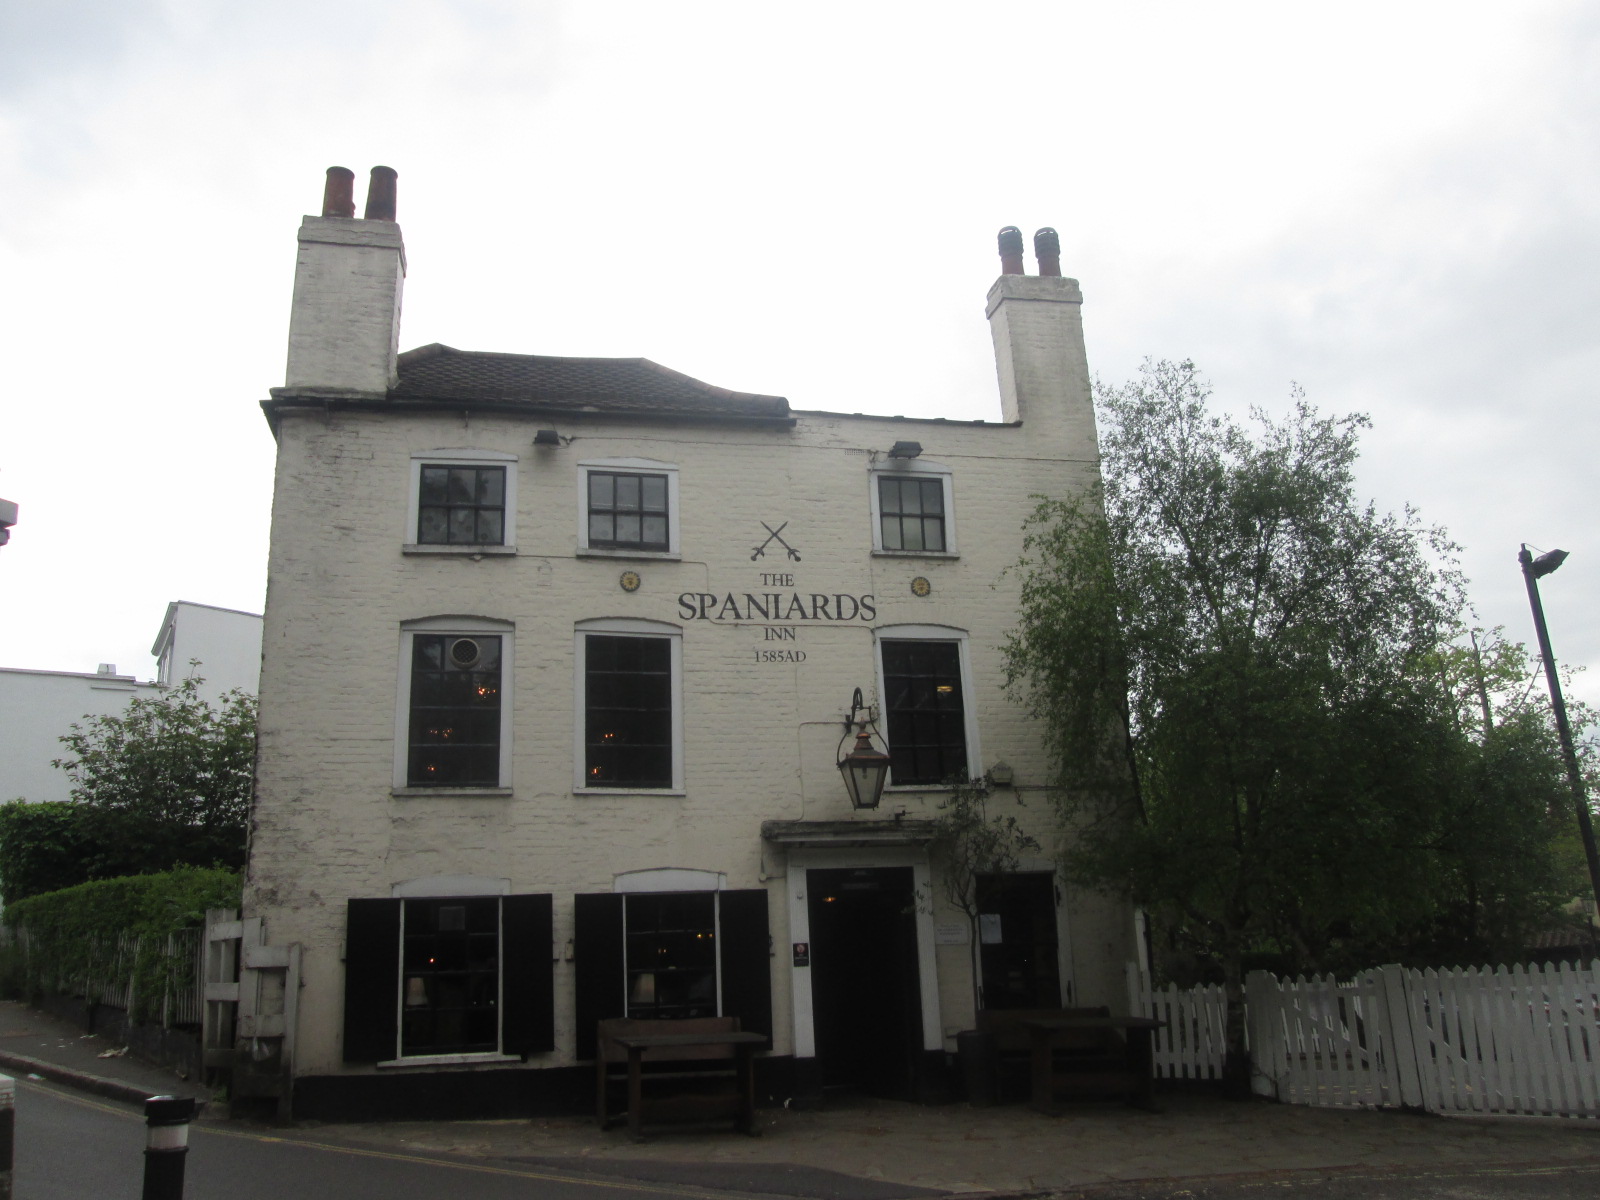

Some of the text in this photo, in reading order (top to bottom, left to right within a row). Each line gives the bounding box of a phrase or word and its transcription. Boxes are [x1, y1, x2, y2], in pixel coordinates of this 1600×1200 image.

[760, 573, 794, 587] THE
[678, 592, 876, 621] SPANIARDS
[764, 627, 796, 641] INN
[755, 650, 807, 663] 1585AD
